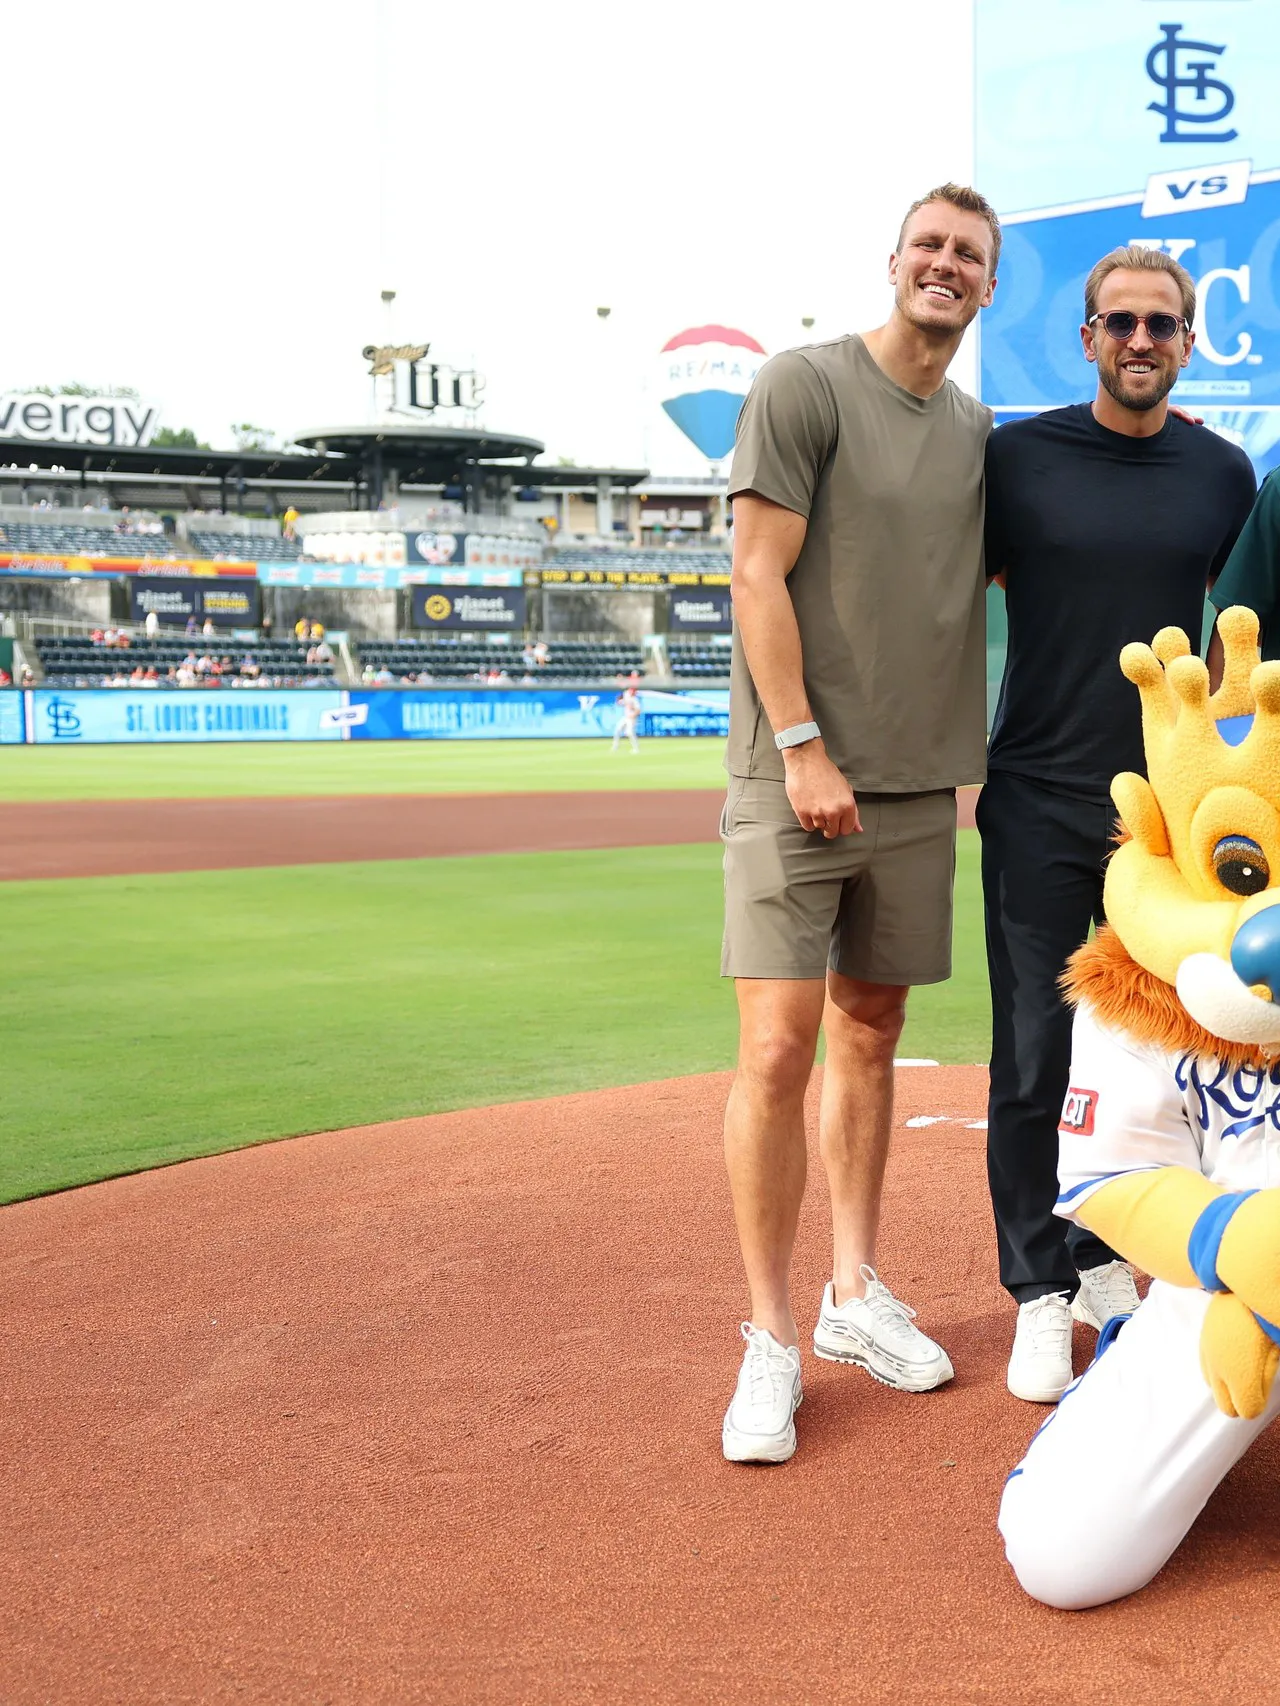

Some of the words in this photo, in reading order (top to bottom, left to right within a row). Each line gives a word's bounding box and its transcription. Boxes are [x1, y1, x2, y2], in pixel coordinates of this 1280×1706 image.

[1167, 176, 1229, 200] VS
[155, 704, 198, 731] LOUIS
[205, 703, 289, 730] CARDINALS
[1061, 1092, 1093, 1129] QT
